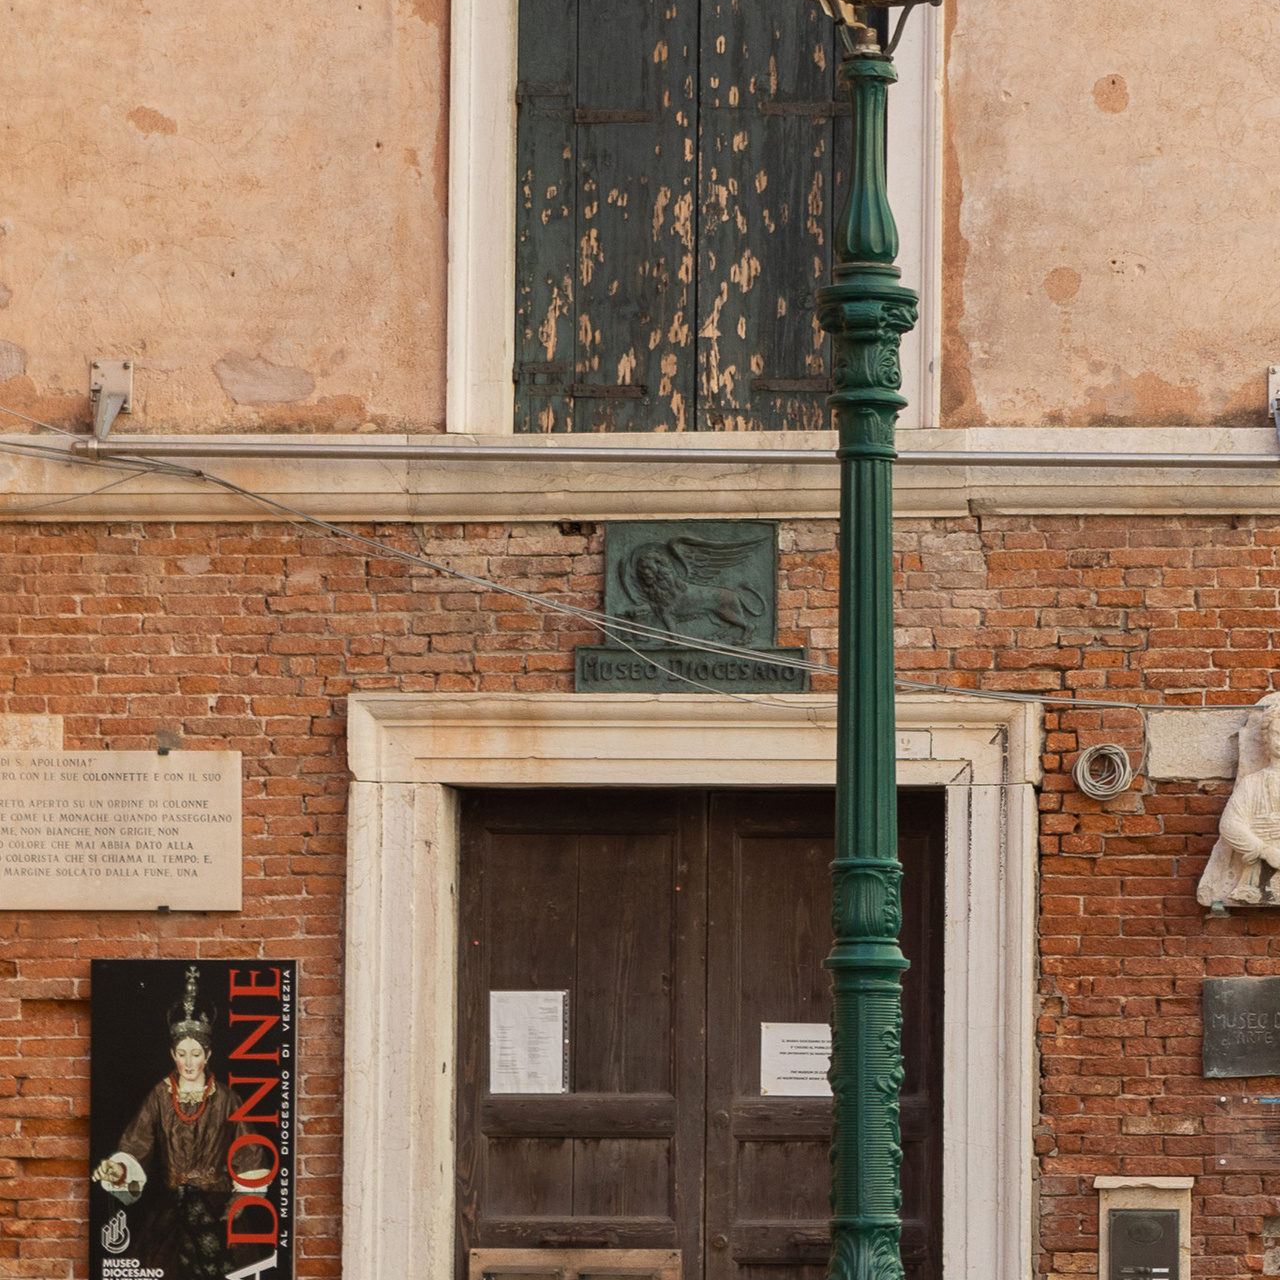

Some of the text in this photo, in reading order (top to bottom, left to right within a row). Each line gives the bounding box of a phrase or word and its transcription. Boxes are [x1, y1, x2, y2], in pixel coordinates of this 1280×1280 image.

[581, 654, 797, 682] MUSEO DIOCESANO
[0, 758, 10, 767] DI
[20, 772, 40, 782] CON
[44, 772, 56, 782] LE
[60, 772, 79, 782] SUE
[82, 772, 148, 782] COLONNETTE
[153, 772, 160, 782] E
[163, 772, 183, 782] CON
[188, 772, 198, 782] IL
[202, 772, 221, 782] SUO
[29, 799, 69, 809] APERTO
[73, 799, 85, 809] SU
[89, 799, 103, 809] UN
[107, 799, 144, 809] ORDINE
[148, 799, 158, 809] DI
[162, 799, 209, 809] COLONNE
[10, 813, 39, 822] COME
[43, 813, 54, 822] LE
[59, 813, 109, 822] MONACHE
[113, 813, 157, 822] QUANDO
[161, 814, 233, 823] PASSEGGIANO
[20, 827, 41, 836] NON
[94, 827, 116, 836] NON
[158, 827, 179, 836] NON
[8, 840, 46, 850] COLORE
[51, 840, 71, 850] CHE
[75, 840, 96, 850] MAI
[100, 840, 131, 850] ABBIA
[135, 840, 162, 850] DATO
[167, 840, 194, 850] ALLA
[6, 854, 59, 863] COLORISTA
[64, 854, 84, 863] CHE
[88, 854, 98, 863] SI
[101, 854, 143, 863] CHIAMA
[147, 854, 157, 863] IL
[4, 868, 50, 877] MARGINE
[55, 868, 102, 877] SOLCATO
[105, 868, 139, 877] DALLA
[177, 868, 198, 877] UNA
[279, 969, 291, 1248] AL MUSEO DIOCESANO DI VENEZIA
[102, 1259, 140, 1268] MUSEO
[102, 1268, 164, 1278] DIOCESANO
